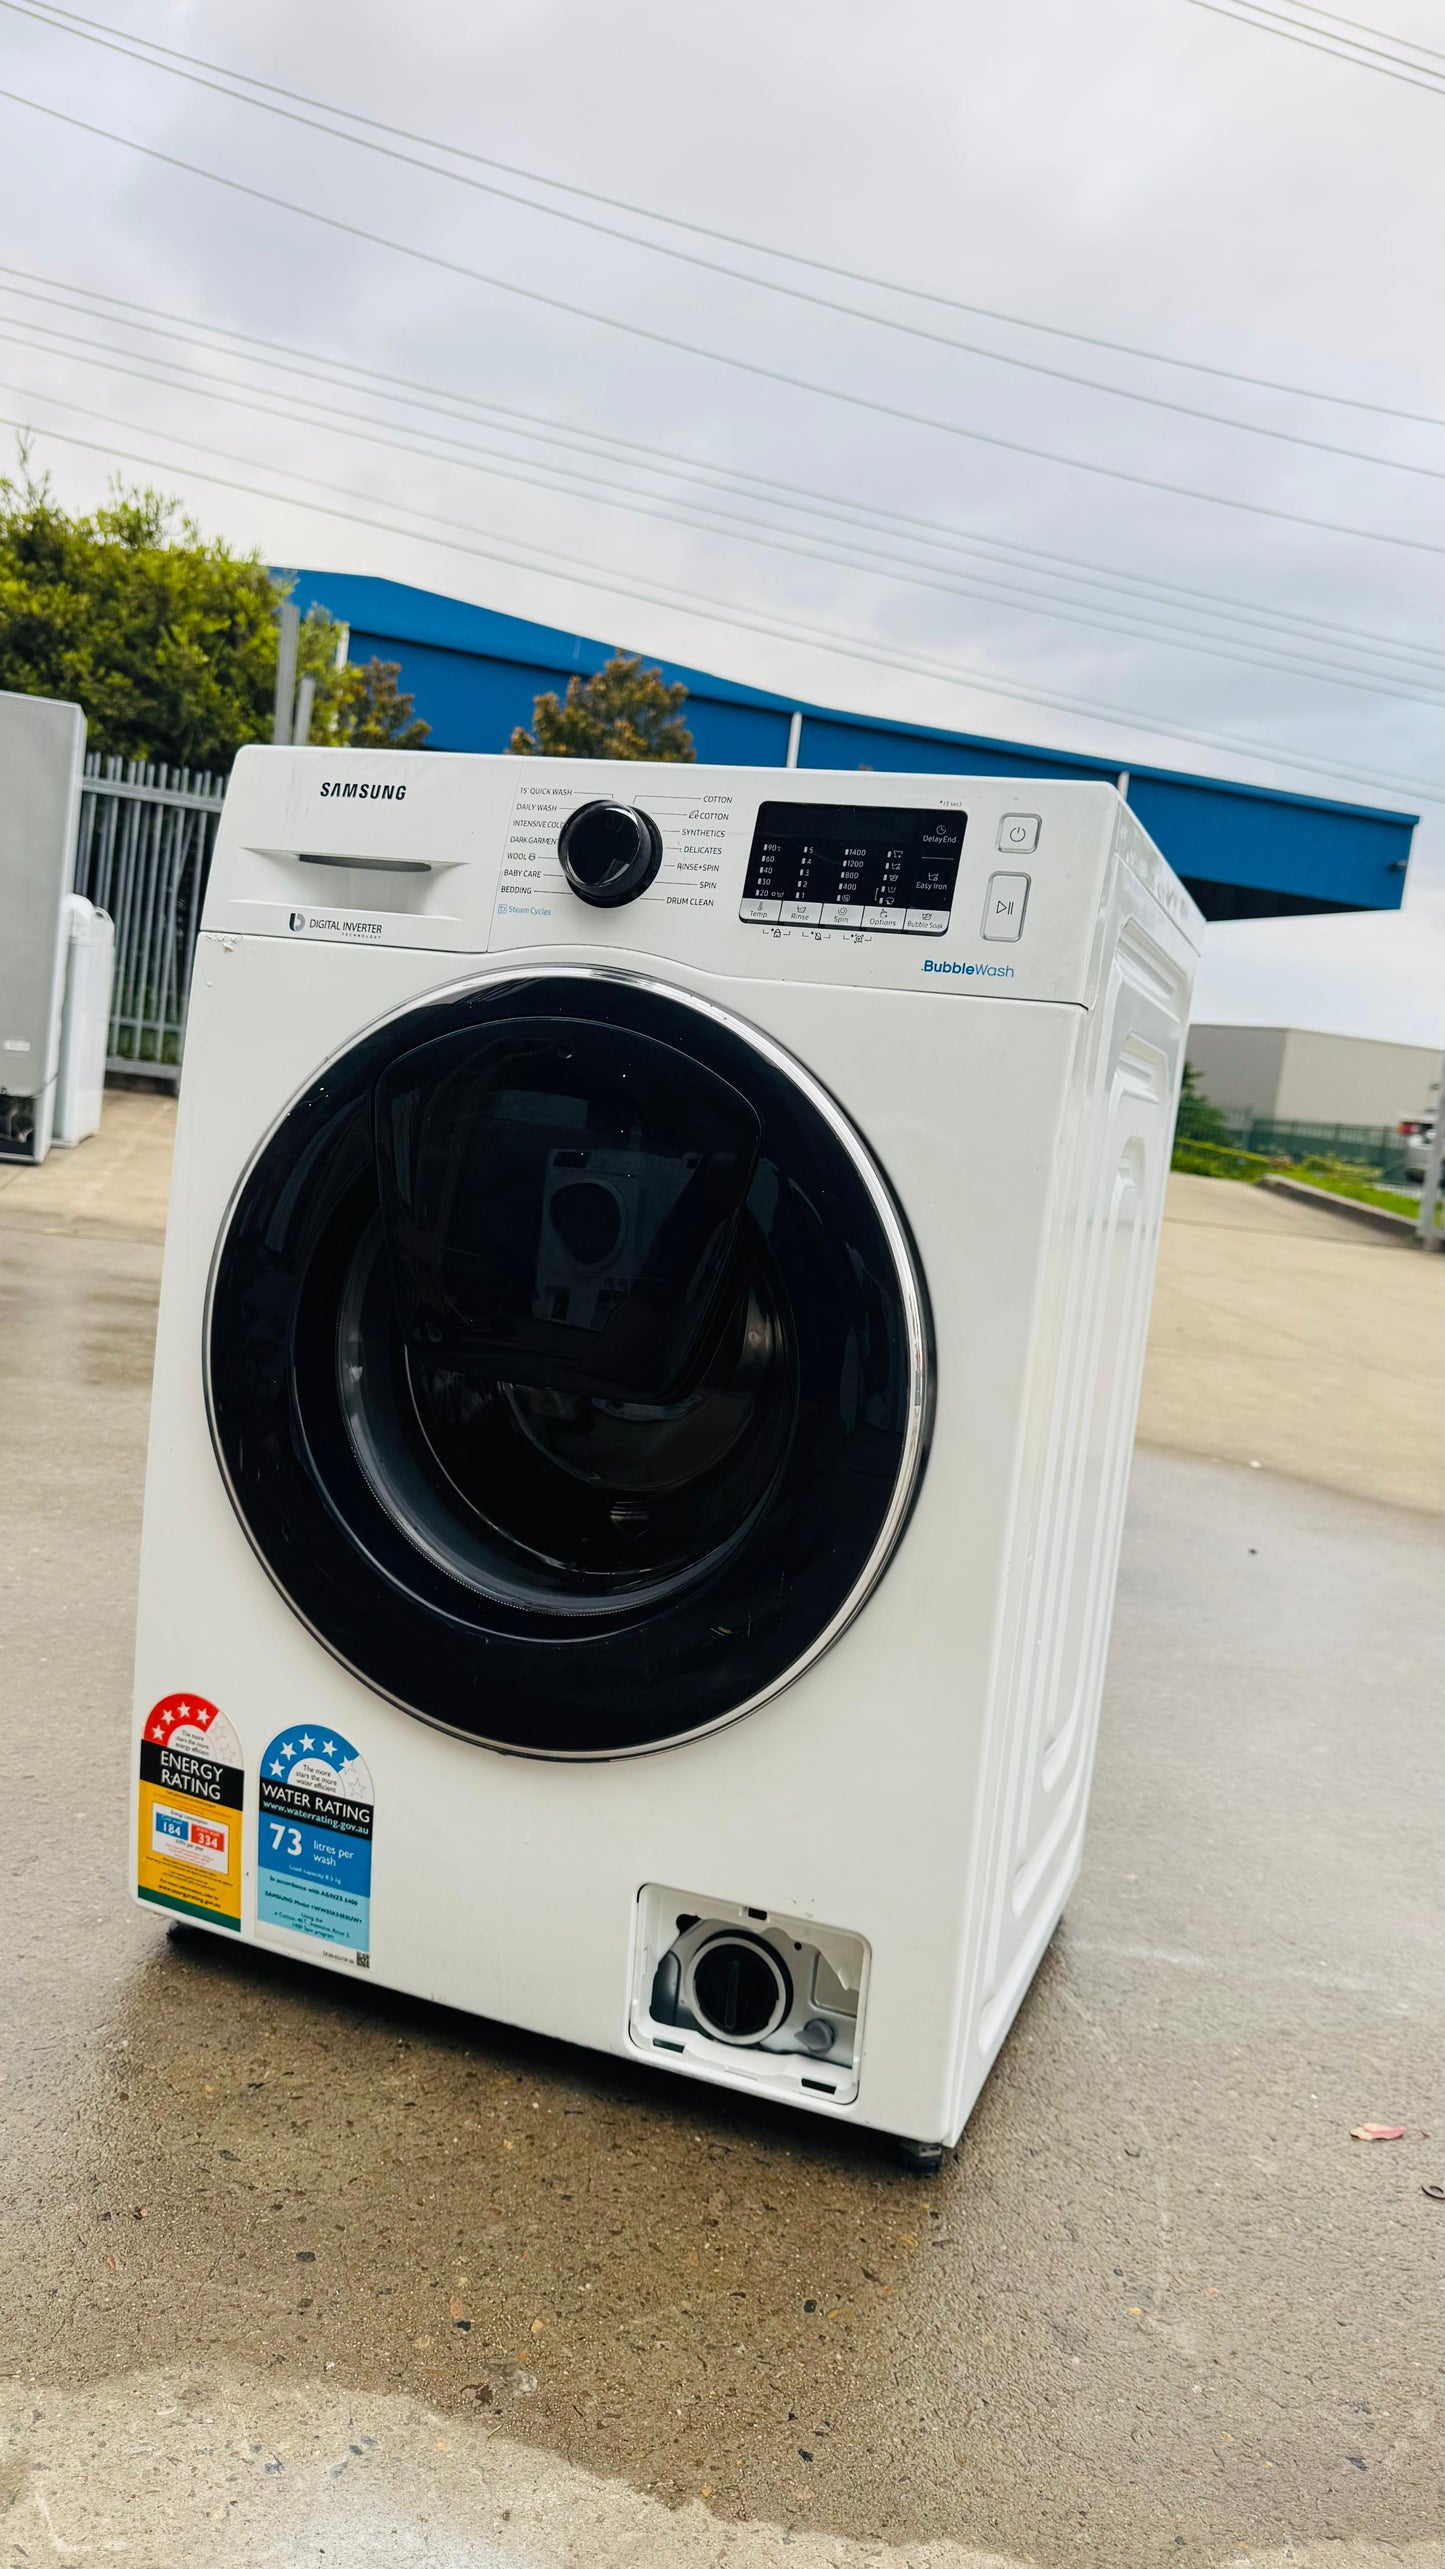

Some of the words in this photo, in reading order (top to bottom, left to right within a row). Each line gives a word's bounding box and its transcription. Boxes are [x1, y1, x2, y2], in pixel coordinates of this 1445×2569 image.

[320, 782, 407, 800] SAMSUNG
[530, 787, 551, 795] QUICK
[552, 788, 573, 796] WASH
[703, 795, 733, 803] COTTON
[700, 812, 729, 820] COTTON
[513, 820, 546, 828] INTENSIVE
[682, 829, 726, 837] SYNTHETICS
[683, 846, 722, 855] DELICATES
[676, 863, 719, 872] RINSE+SPIN
[847, 860, 864, 868] 1200
[504, 869, 522, 877] BABY
[523, 870, 541, 878] CARE
[699, 881, 717, 889] SPIN
[843, 883, 857, 891] 400
[916, 882, 932, 890] Easy
[933, 882, 947, 890] Iron
[501, 886, 532, 894] BEDDING
[760, 889, 769, 897] 20
[666, 897, 688, 905] DRUM
[690, 898, 714, 906] CLEAN
[508, 905, 529, 914] Steam
[530, 907, 552, 916] Cycles
[750, 909, 768, 918] Temp
[791, 912, 809, 920] Rinse
[834, 915, 849, 924] Spin
[309, 918, 341, 931] DIGITAL
[342, 922, 382, 934] INVERTER
[869, 917, 897, 927] Options
[907, 920, 928, 928] Bubble
[929, 921, 943, 929] Soak
[161, 1750, 223, 1782] ENERGY
[303, 1764, 315, 1773] The
[315, 1768, 331, 1778] more
[296, 1771, 310, 1779] stars
[311, 1773, 321, 1782] the
[322, 1776, 337, 1786] more
[296, 1779, 313, 1787] water
[162, 1769, 221, 1800] RATING
[262, 1782, 311, 1808] WATER
[315, 1797, 370, 1823] RATING
[263, 1800, 369, 1835] www.waterrating.gov.au
[163, 1821, 181, 1836] 184
[198, 1832, 218, 1848] 334
[269, 1822, 303, 1856] 73
[313, 1840, 336, 1855] litres
[338, 1849, 354, 1859] per
[313, 1854, 336, 1867] wash
